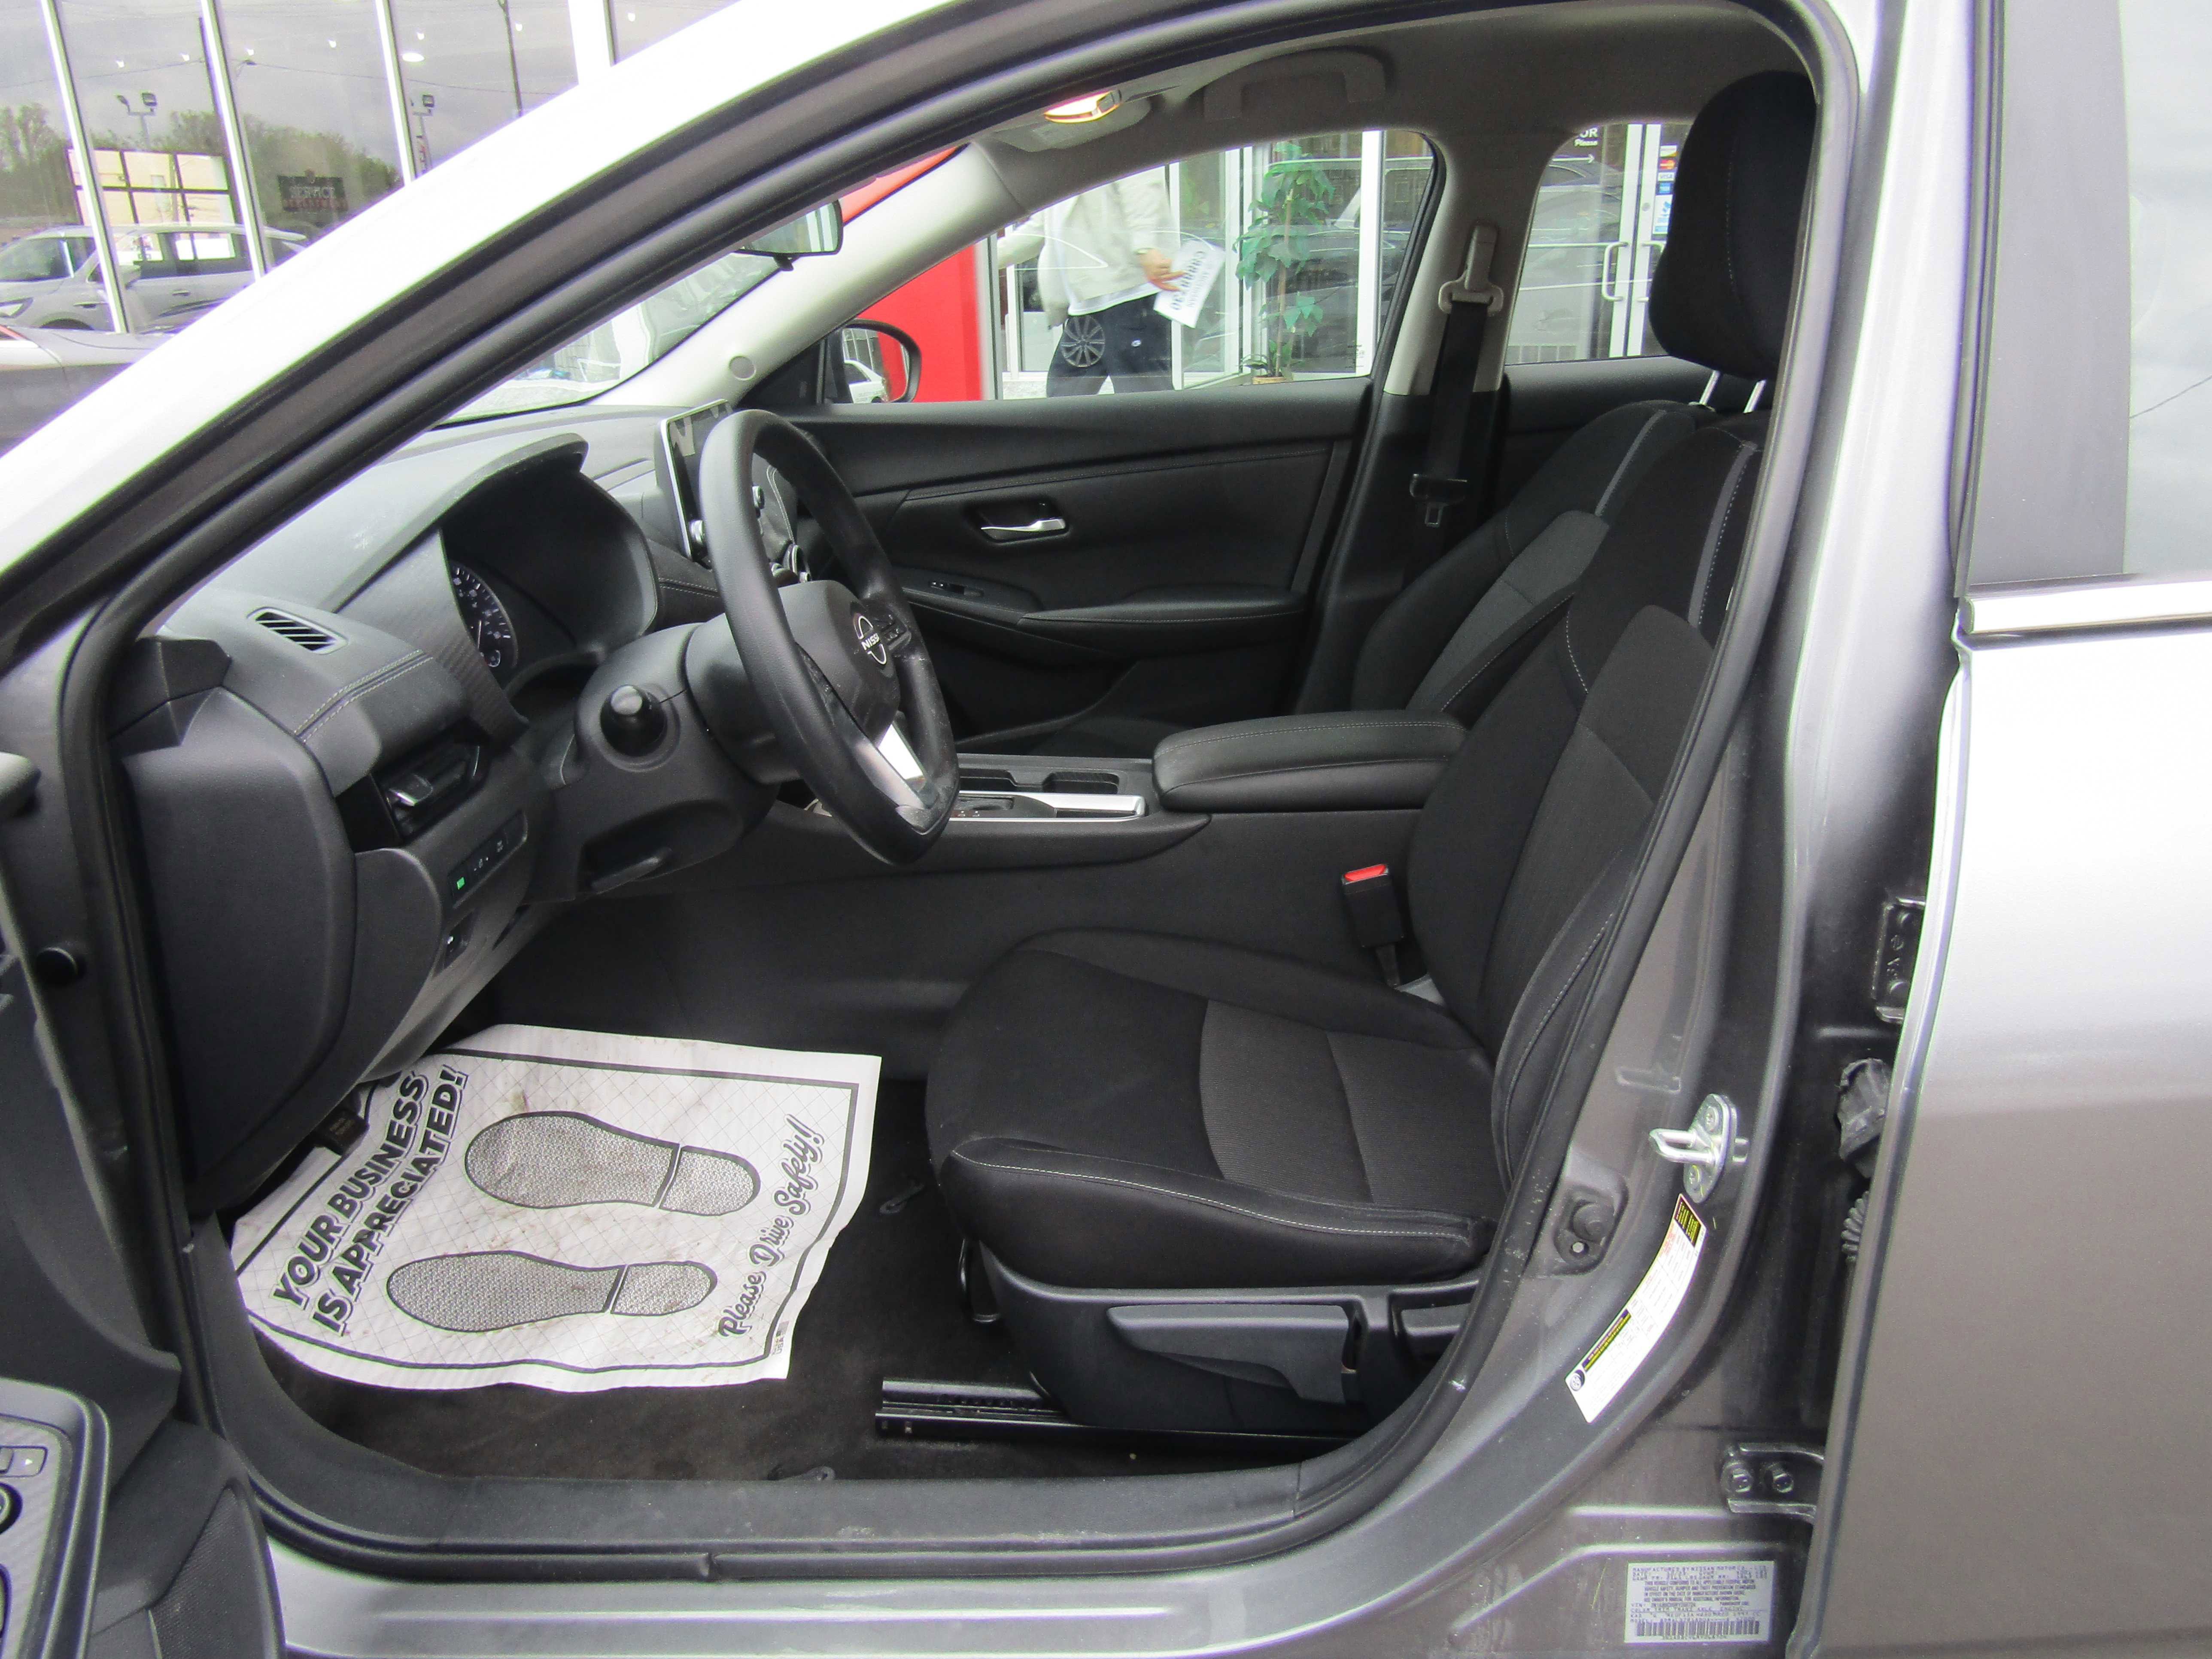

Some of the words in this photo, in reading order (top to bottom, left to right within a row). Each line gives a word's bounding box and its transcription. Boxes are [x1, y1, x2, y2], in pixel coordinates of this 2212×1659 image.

[272, 1214, 343, 1310] YOUR
[328, 1071, 429, 1220] BUSINESS
[331, 1065, 469, 1304] APPRECIATED!
[717, 1270, 767, 1339] Please
[747, 1214, 793, 1267] Drive
[774, 1114, 824, 1216] Safely!
[309, 1289, 356, 1336] IS
